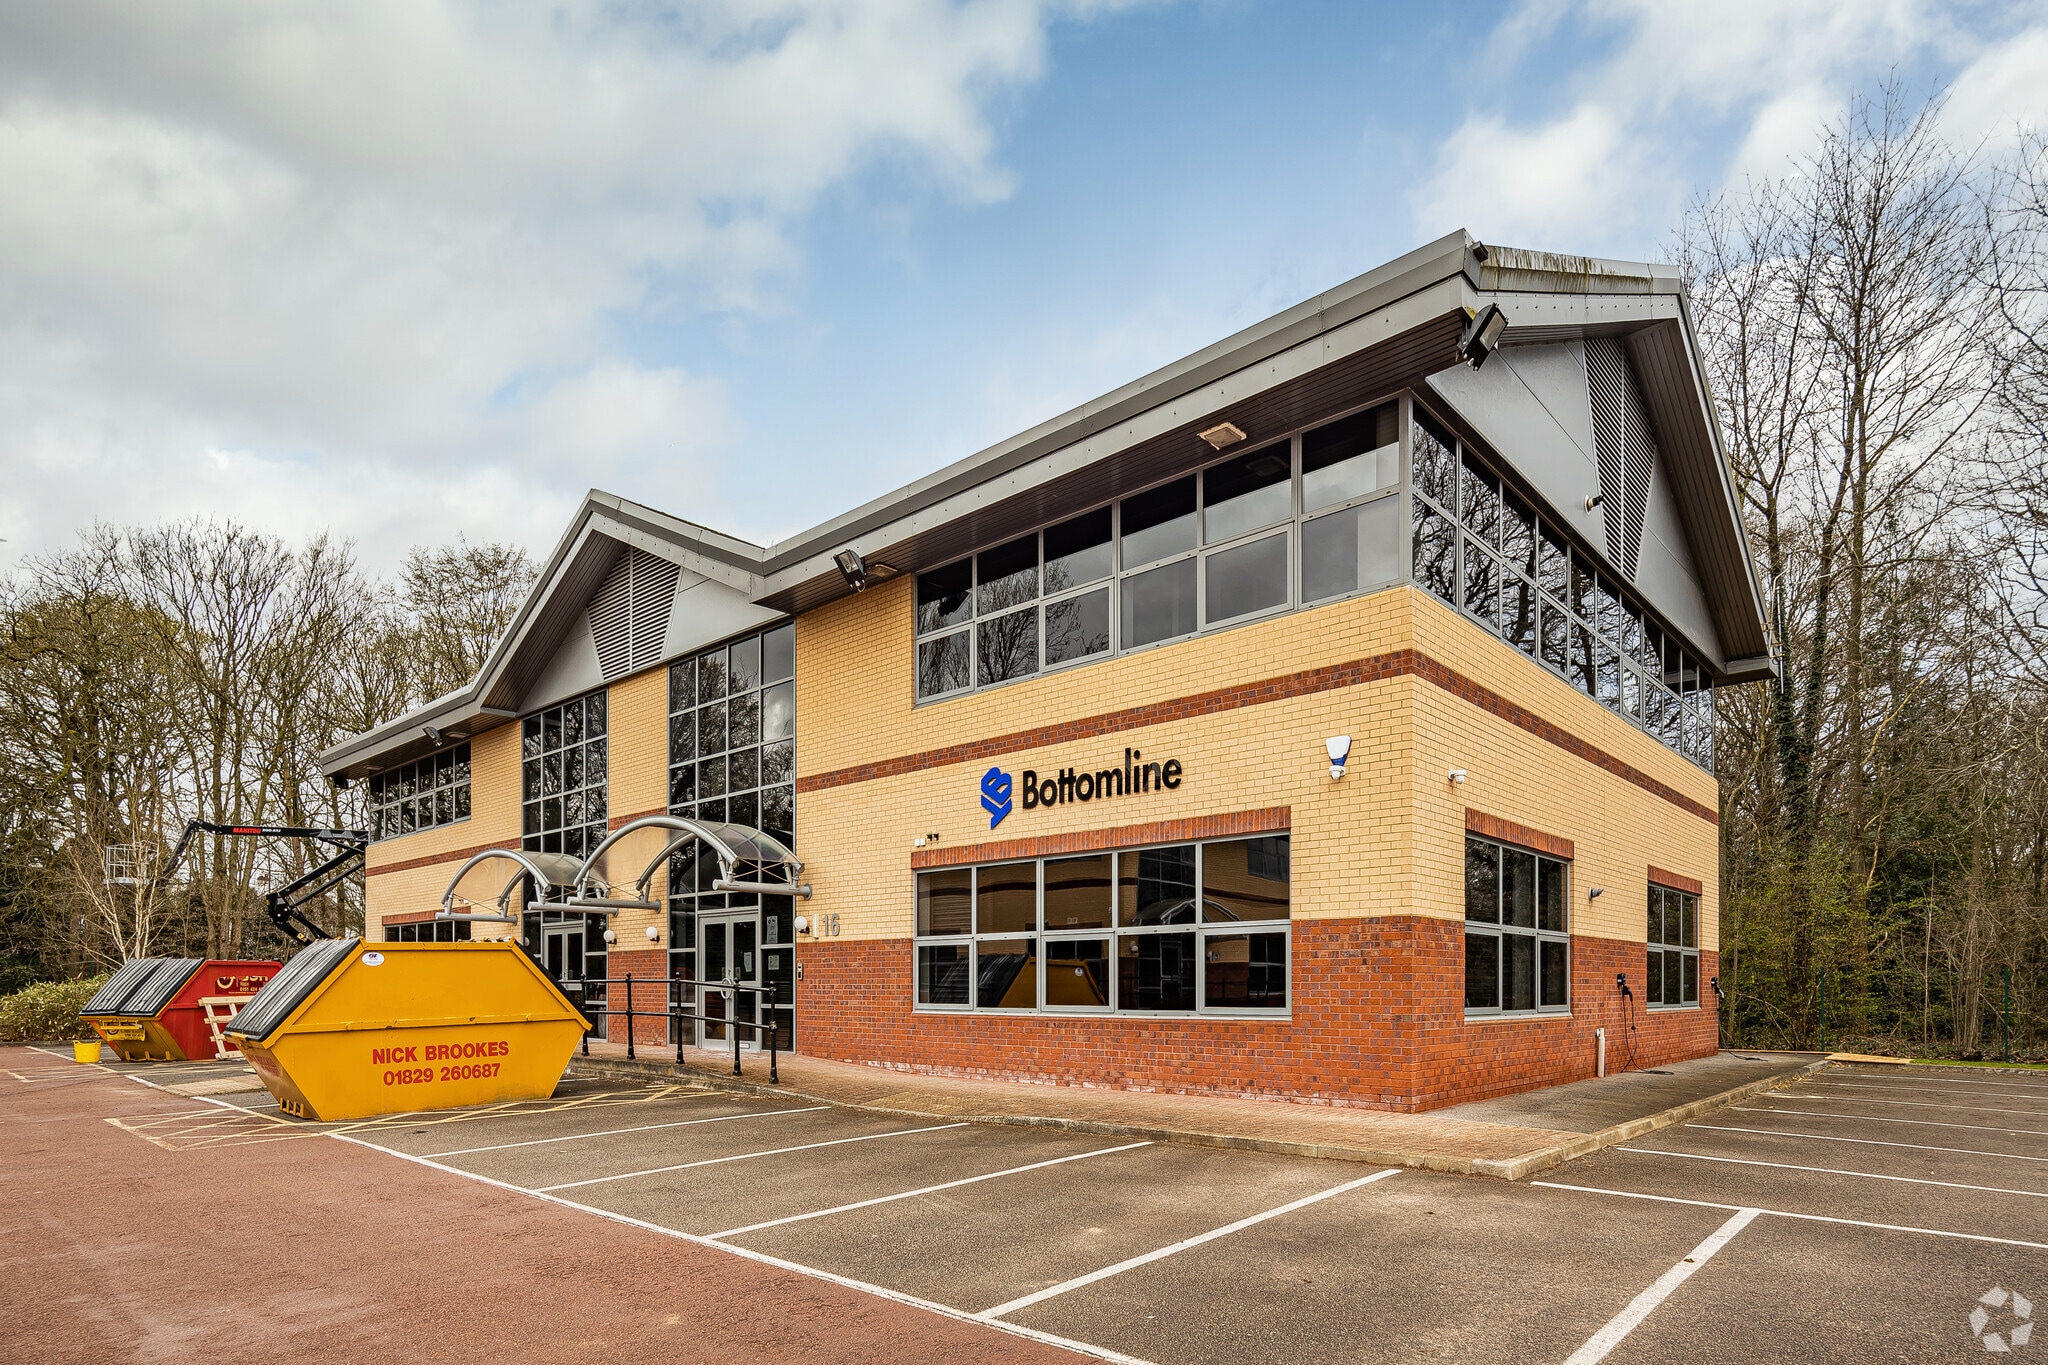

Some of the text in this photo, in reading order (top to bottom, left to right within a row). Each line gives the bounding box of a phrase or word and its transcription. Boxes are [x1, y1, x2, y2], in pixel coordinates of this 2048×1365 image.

[1022, 747, 1183, 810] Bottomline
[822, 913, 841, 937] 16
[372, 1041, 510, 1065] NICK BROOKES
[383, 1062, 501, 1086] 01829 260687
